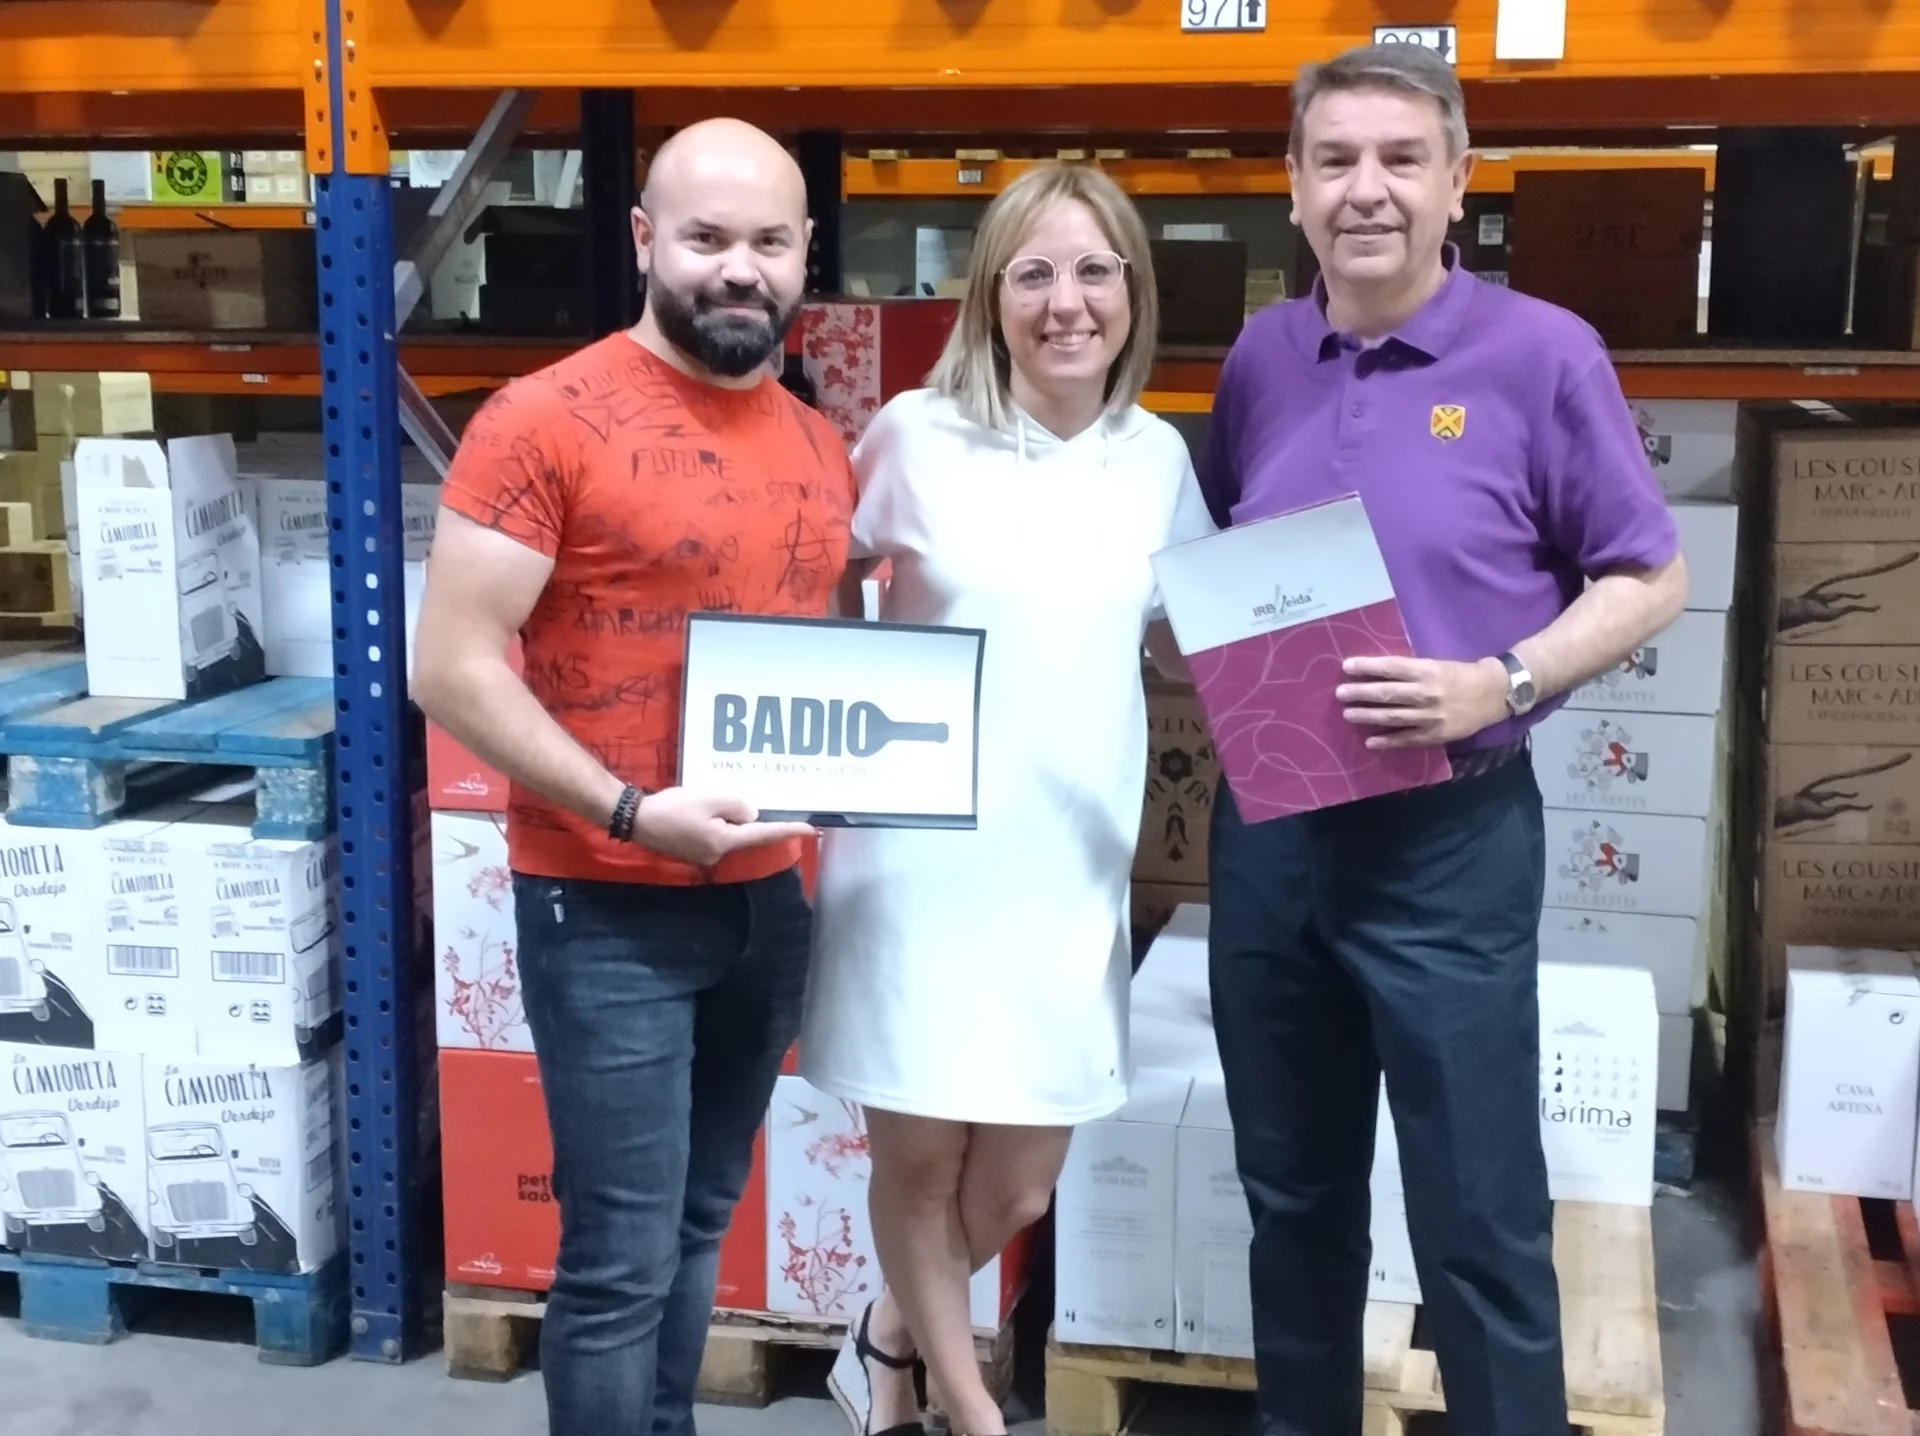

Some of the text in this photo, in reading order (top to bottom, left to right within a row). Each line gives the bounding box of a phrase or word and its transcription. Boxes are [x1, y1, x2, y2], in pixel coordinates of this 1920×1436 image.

[631, 448, 738, 481] FUTURE
[1793, 458, 1837, 479] LES
[1252, 603, 1276, 618] IRB
[1790, 663, 1920, 683] LES COUSI
[712, 692, 895, 759] BADIO
[1783, 859, 1825, 879] LES
[14, 882, 66, 898] Verdejo
[13, 1060, 117, 1095] CAMIONETA
[165, 1071, 273, 1107] CAMIONETA
[1835, 1084, 1876, 1097] CAVA
[68, 1096, 120, 1112] Verdejo
[1827, 1100, 1883, 1115] ARTESA
[221, 1106, 275, 1124] Verdejo
